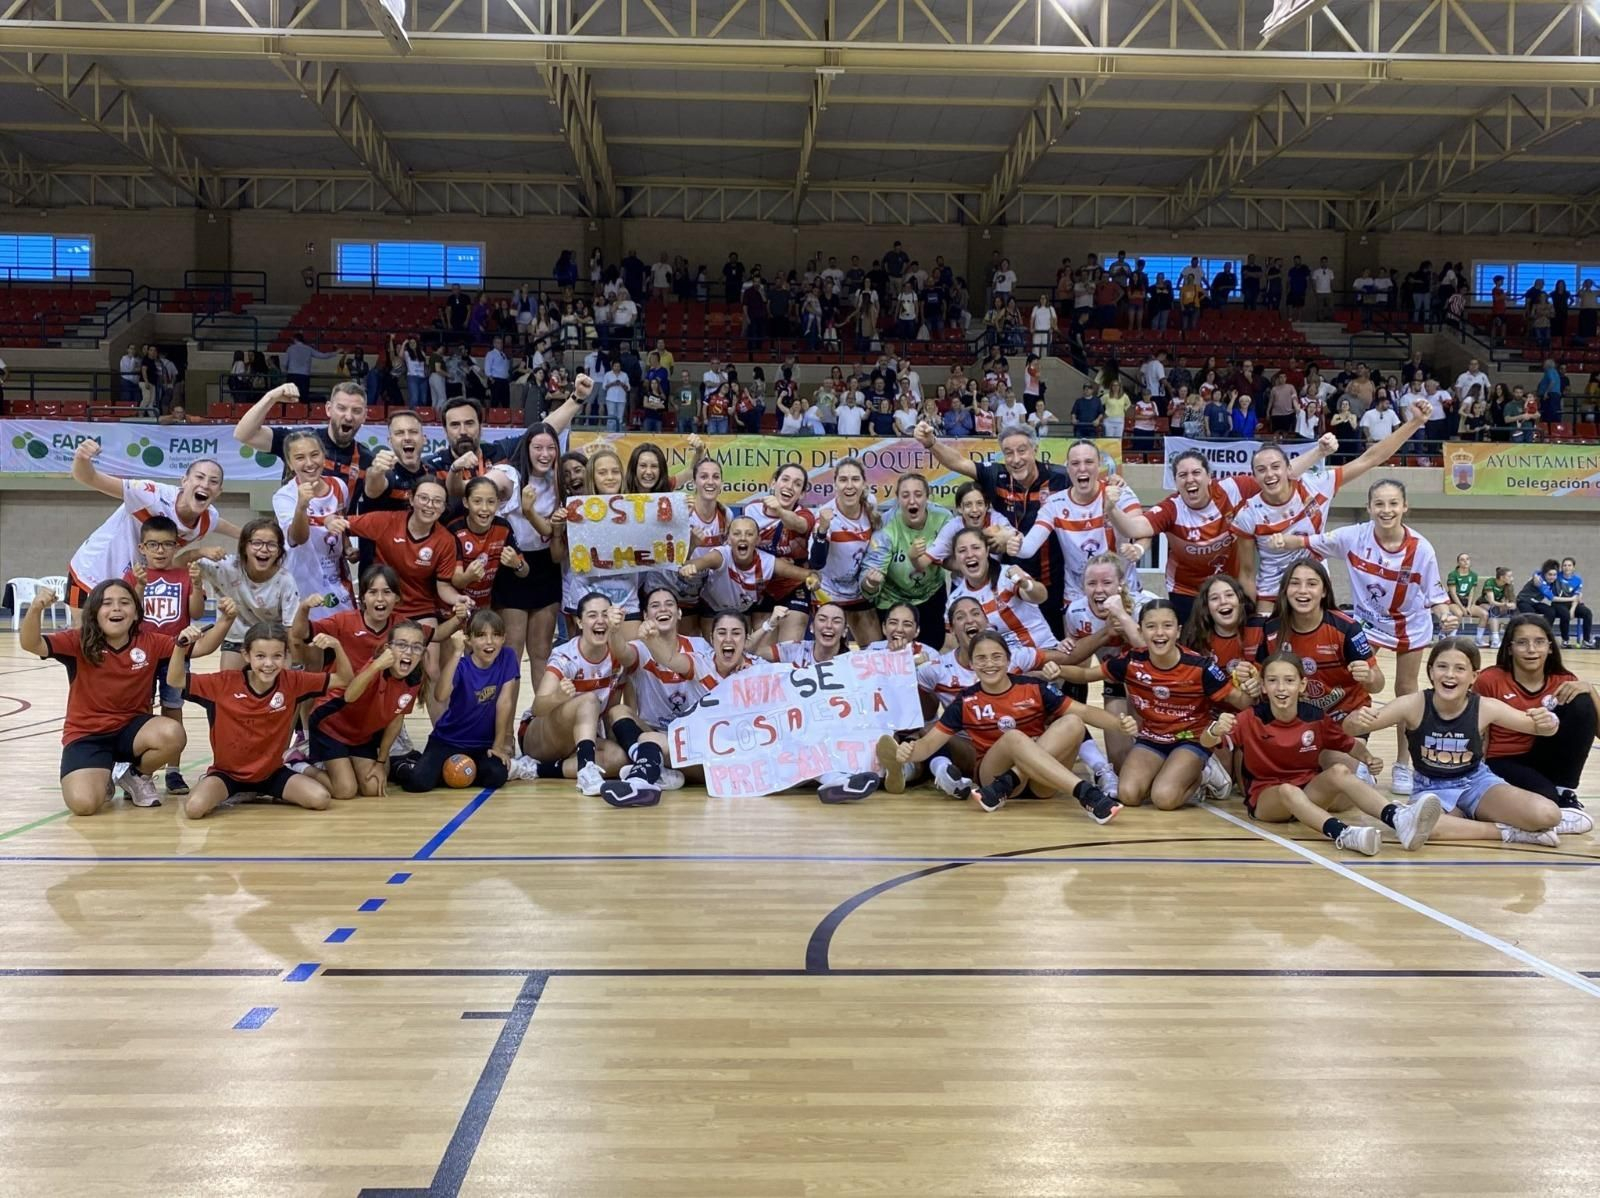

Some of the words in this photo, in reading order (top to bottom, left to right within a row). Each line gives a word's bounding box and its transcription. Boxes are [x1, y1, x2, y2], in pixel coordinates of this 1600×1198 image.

[169, 439, 218, 454] FABM
[884, 485, 892, 497] y
[1507, 477, 1590, 491] Delegación
[566, 496, 672, 525] COSTA
[464, 541, 474, 555] 9
[145, 597, 176, 619] NFL
[790, 661, 845, 698] SE
[972, 704, 996, 721] 14
